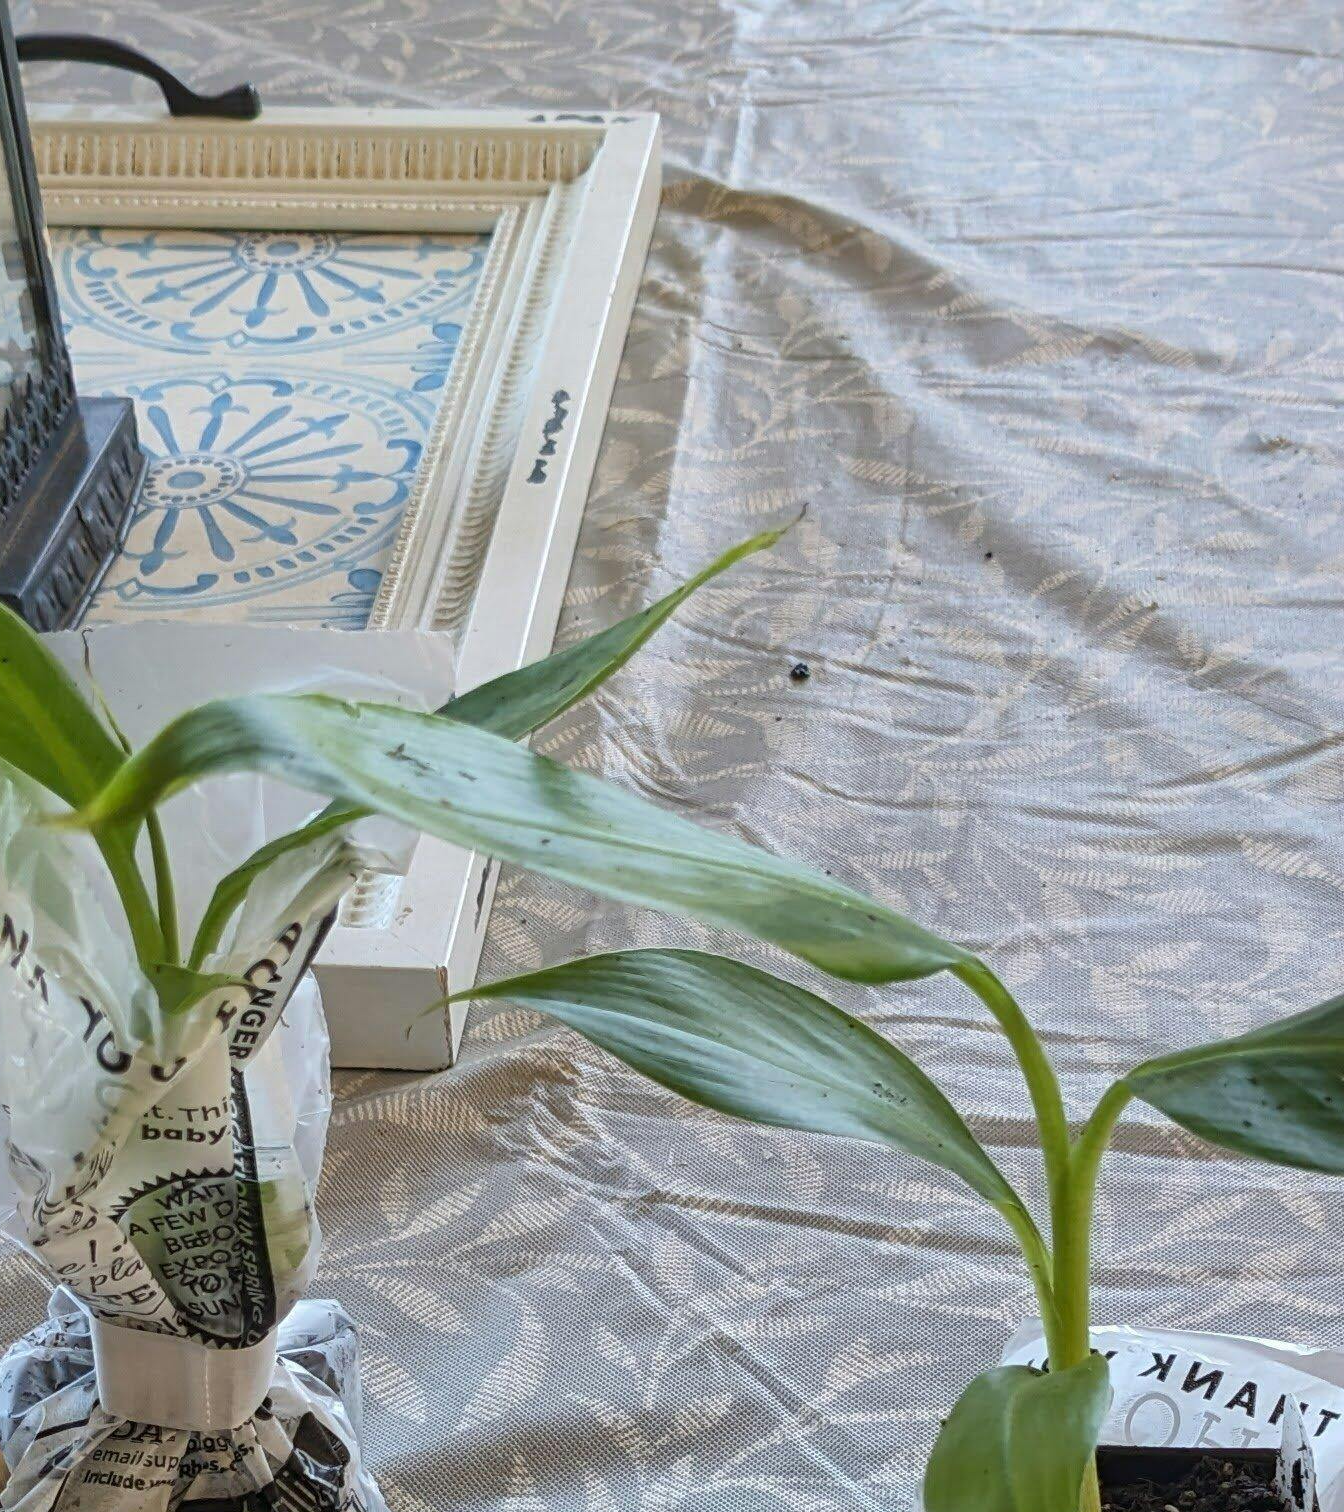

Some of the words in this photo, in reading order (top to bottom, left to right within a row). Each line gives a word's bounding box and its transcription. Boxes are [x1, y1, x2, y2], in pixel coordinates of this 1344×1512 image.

[154, 1182, 227, 1211] WAIT
[128, 1222, 149, 1240] A
[148, 1208, 208, 1234] FEW
[186, 1296, 240, 1320] SUN
